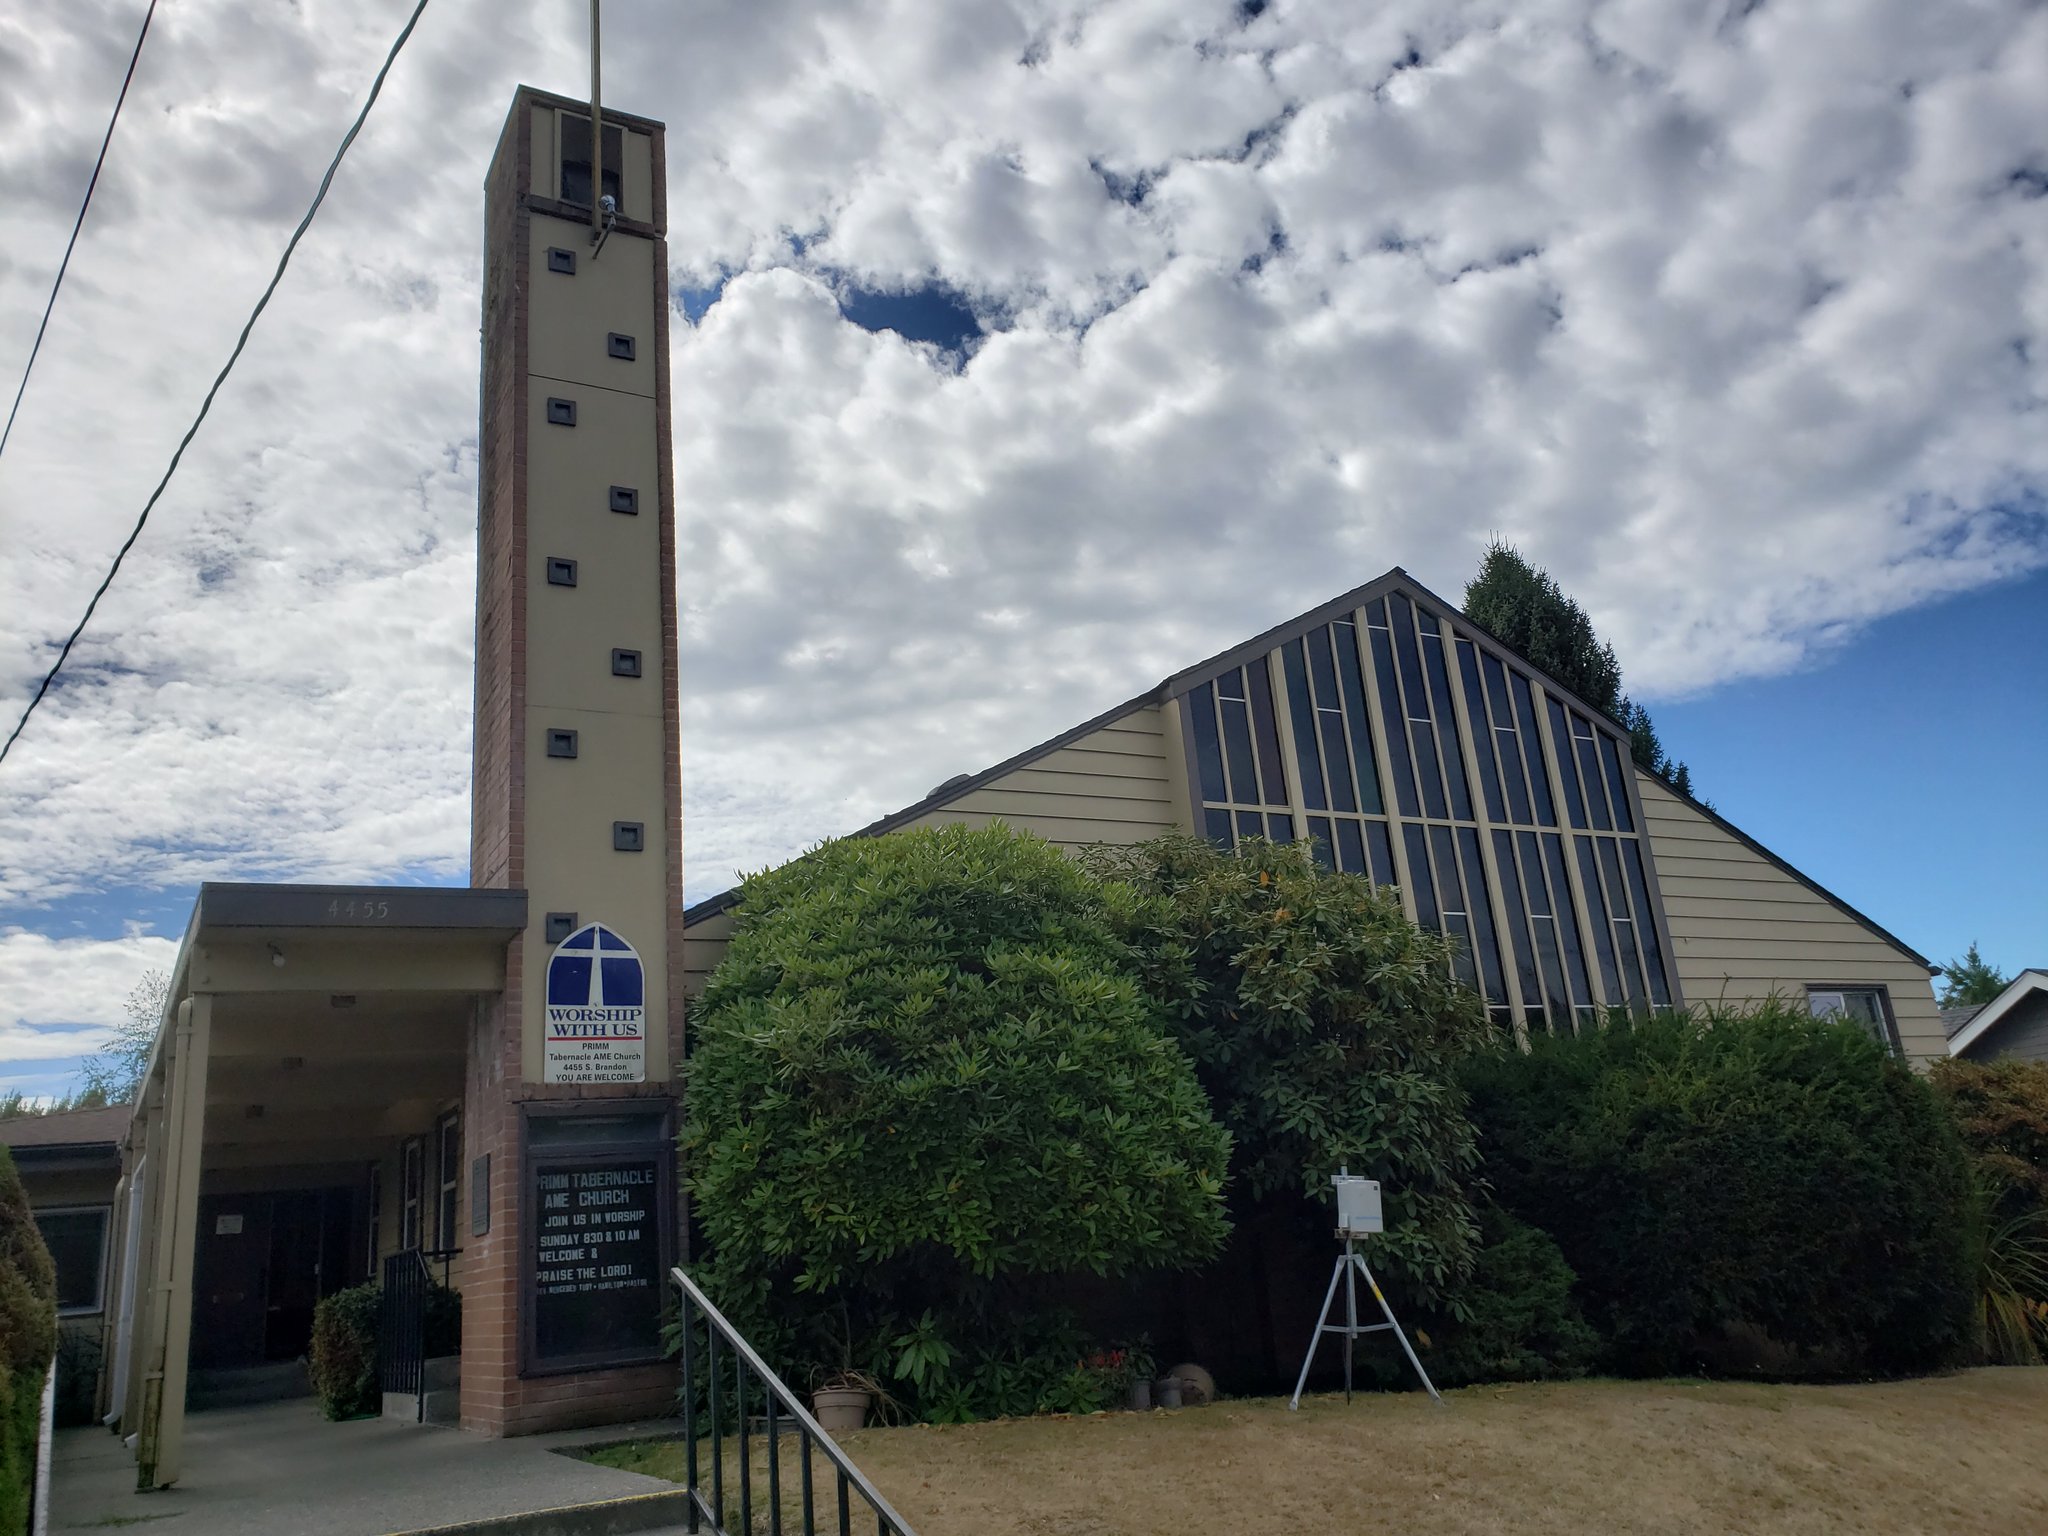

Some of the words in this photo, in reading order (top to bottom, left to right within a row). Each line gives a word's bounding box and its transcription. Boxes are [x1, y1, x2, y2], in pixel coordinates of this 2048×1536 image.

[328, 899, 388, 919] 4455
[549, 1008, 642, 1022] WORSHIP
[553, 1024, 607, 1036] WITH
[613, 1023, 638, 1036] US
[582, 1042, 610, 1050] PRIMM
[549, 1053, 592, 1061] Tabernacle
[593, 1053, 612, 1061] AME
[613, 1052, 641, 1061] Church
[563, 1063, 583, 1071] 4455
[585, 1063, 594, 1071] S.
[595, 1063, 627, 1071] Brandon
[556, 1073, 574, 1082] YOU
[576, 1073, 593, 1081] ARE
[594, 1073, 635, 1081] WELCOME
[572, 1169, 654, 1188] TABERNACLE
[545, 1192, 570, 1209] AME
[579, 1189, 630, 1207] CHURCH
[545, 1214, 568, 1227] JOIN
[573, 1214, 587, 1225] US
[591, 1212, 601, 1224] IN
[605, 1210, 645, 1223] WORSHIP
[540, 1233, 580, 1247] SUNDAY
[583, 1231, 603, 1244] 830
[615, 1230, 626, 1241] 10
[628, 1229, 640, 1240] AM
[539, 1248, 585, 1262] WELCOME
[536, 1268, 574, 1282] PRAISE
[576, 1267, 596, 1279] THE
[601, 1264, 632, 1277] LORD!
